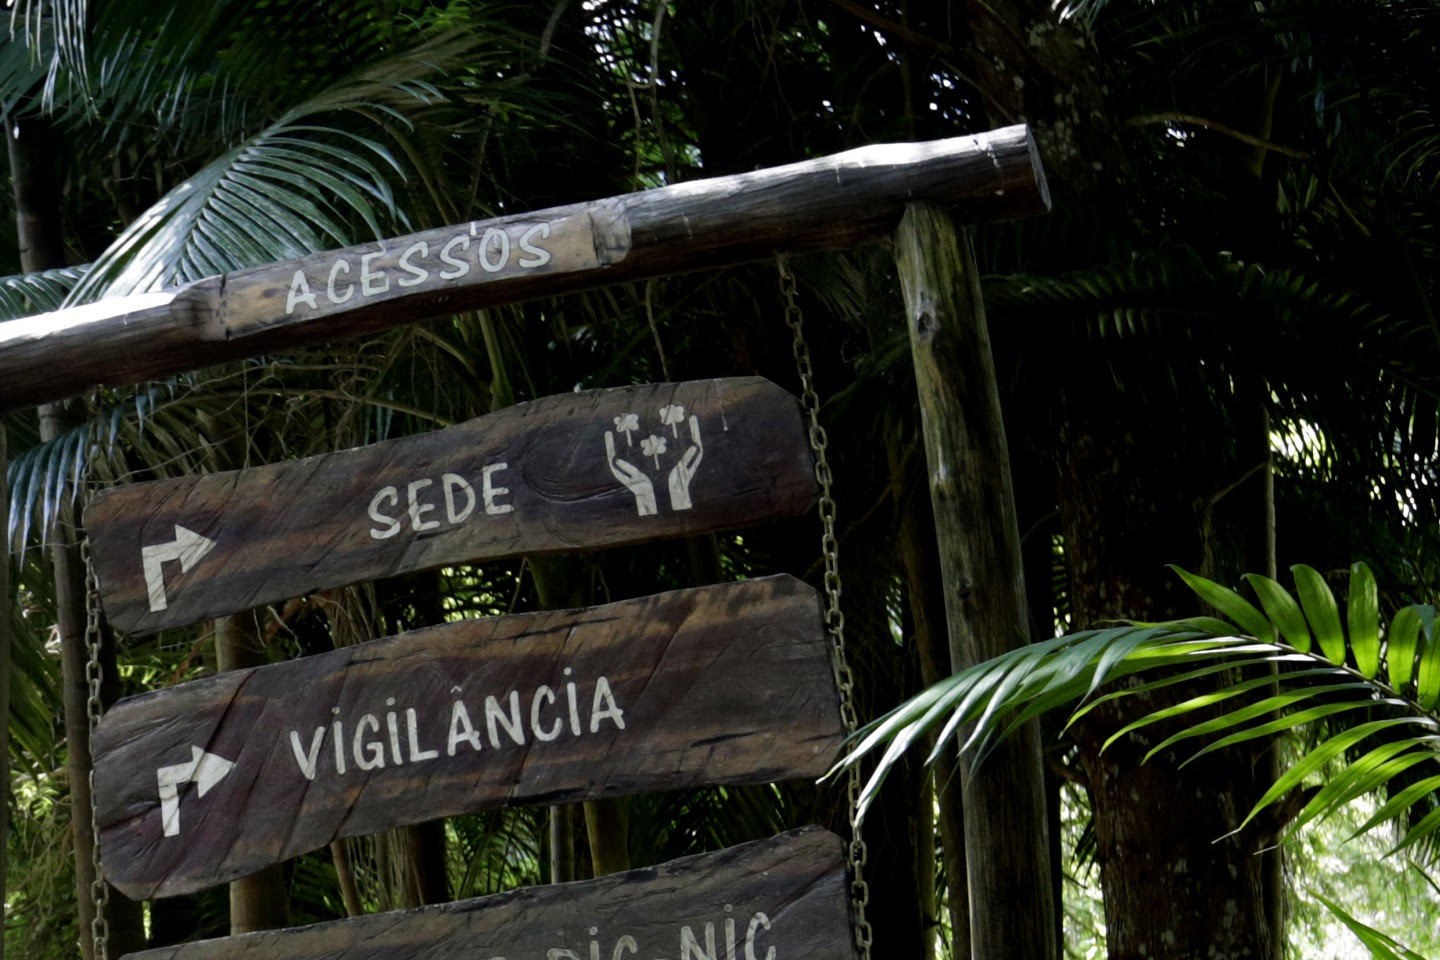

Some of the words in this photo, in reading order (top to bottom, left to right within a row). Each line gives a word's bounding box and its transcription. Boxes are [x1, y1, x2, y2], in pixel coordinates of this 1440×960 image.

[285, 222, 552, 315] ACESSOS
[368, 462, 514, 540] SEDE
[290, 667, 626, 780] VIGILÂNCIA
